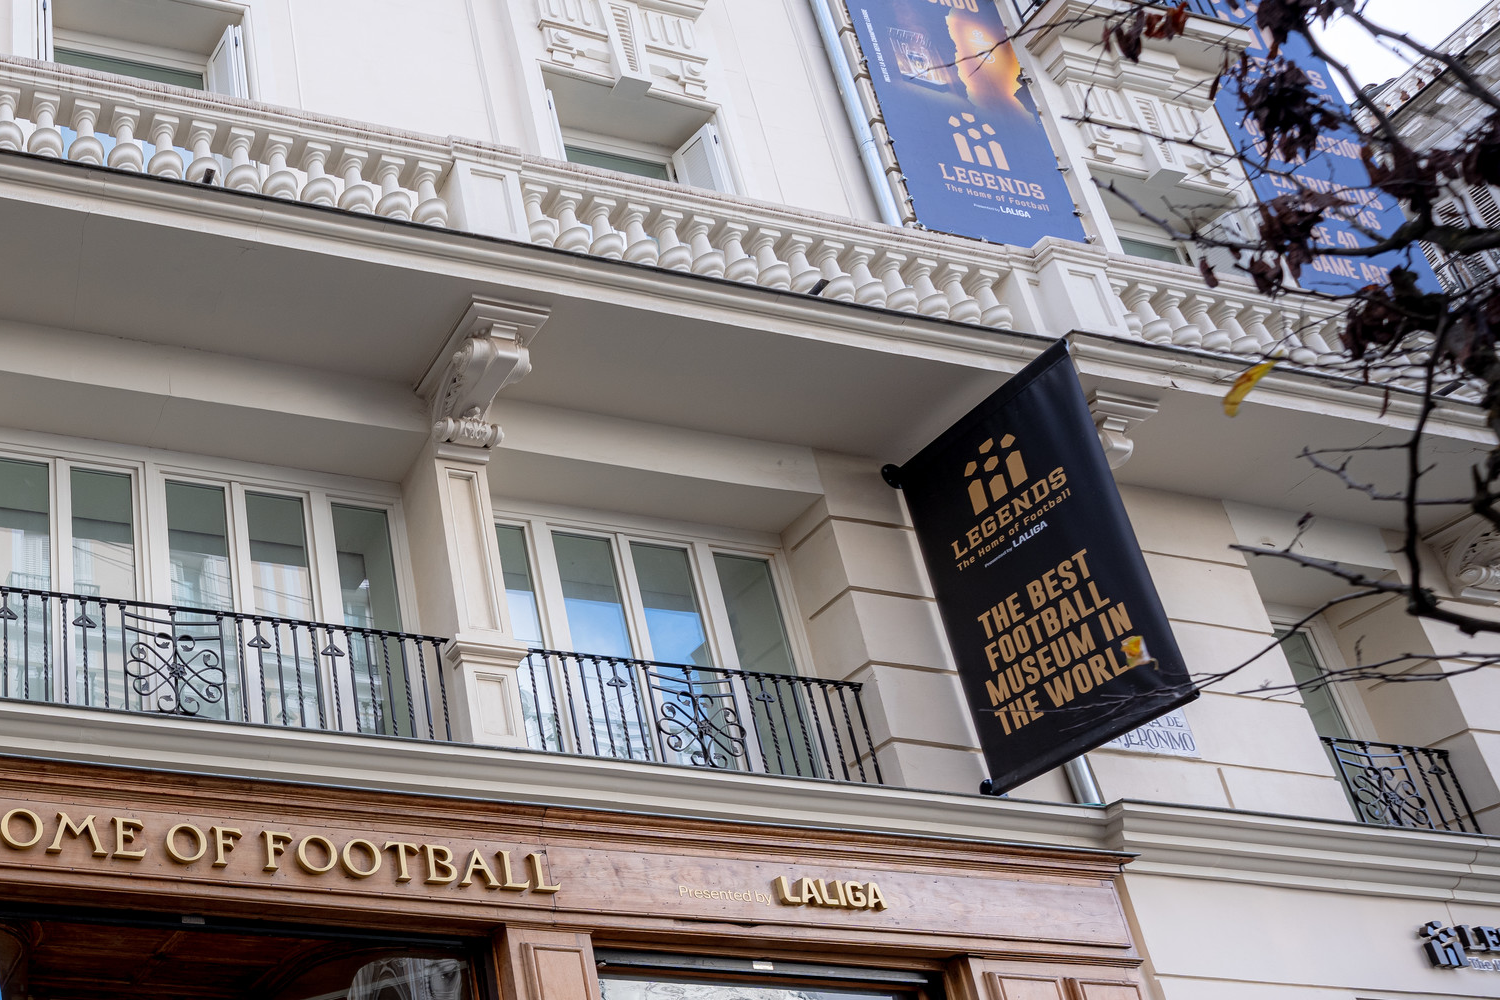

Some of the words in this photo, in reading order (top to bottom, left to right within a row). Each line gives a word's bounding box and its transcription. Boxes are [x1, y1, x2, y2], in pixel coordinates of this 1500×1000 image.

[938, 163, 1046, 200] LEGENDS
[945, 183, 963, 193] The
[966, 188, 992, 200] Home
[1009, 197, 1050, 212] Football
[1000, 206, 1031, 219] LALIGA
[1359, 262, 1392, 285] ARE
[950, 466, 1067, 560] LEGENDS
[956, 556, 975, 572] The
[978, 534, 1005, 558] Home
[1008, 522, 1020, 536] of
[1023, 488, 1071, 526] Football
[1012, 520, 1048, 548] LALIGA
[977, 592, 1025, 640] THE
[1026, 548, 1092, 611] BEST
[984, 581, 1110, 672] FOOTBALL
[985, 622, 1097, 707] MUSEUM
[1098, 601, 1134, 642] IN
[994, 689, 1045, 736] THE
[1043, 637, 1142, 708] WORL
[1166, 716, 1183, 728] DE
[165, 823, 243, 868] OF
[260, 830, 562, 895] FOOTBALL
[678, 885, 752, 903] Presented
[755, 889, 772, 906] by
[774, 875, 888, 912] LALIGA
[1453, 925, 1500, 952] LE
[1468, 957, 1493, 971] The
